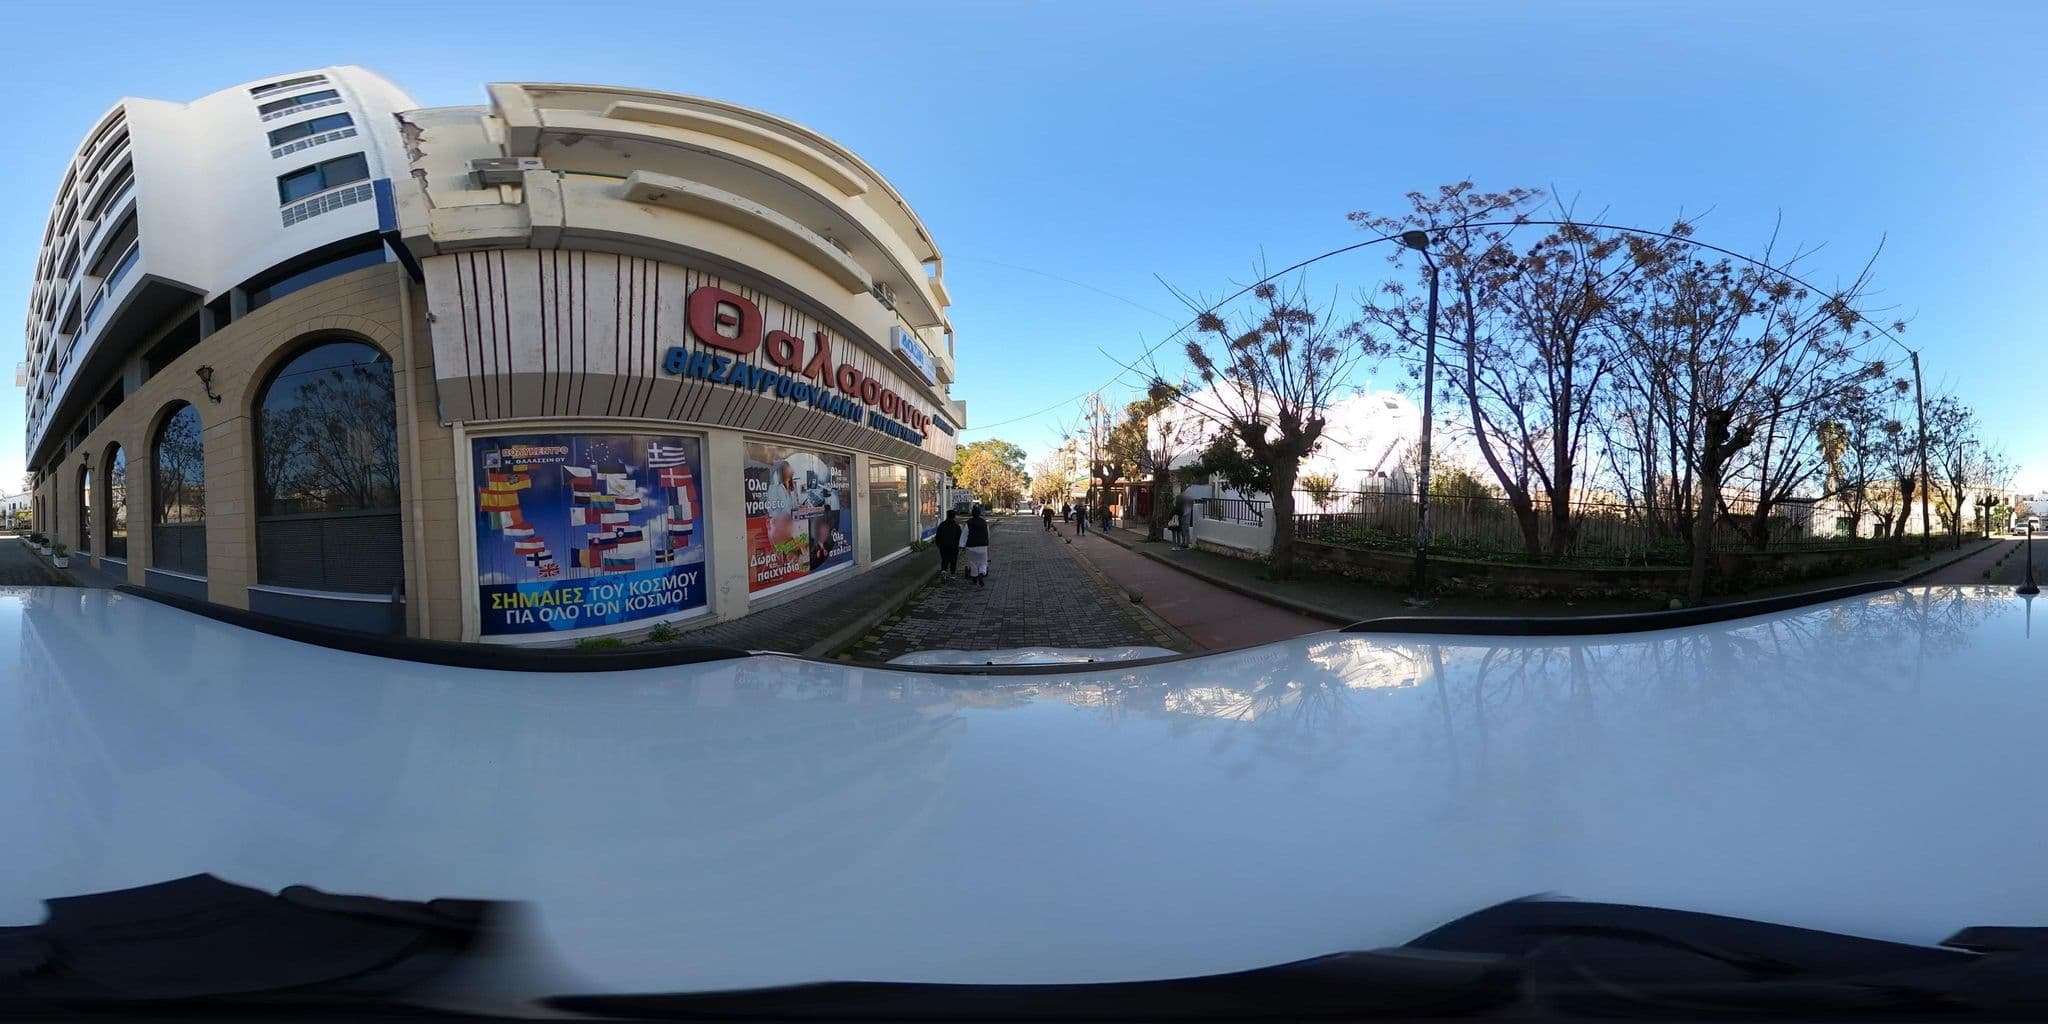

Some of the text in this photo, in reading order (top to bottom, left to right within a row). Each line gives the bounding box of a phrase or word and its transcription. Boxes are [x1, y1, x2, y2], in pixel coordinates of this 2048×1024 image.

[688, 286, 931, 439] Θαλασσινος
[663, 346, 864, 423] ΘΗΣΑΥΡΟΦΥΛΑΚΙΟ
[516, 457, 565, 465] ΘΑΛΑΣΣΙΝΟΥ
[745, 478, 768, 491] Όλα
[750, 552, 777, 567] Δώρα
[757, 561, 800, 582] παιχνίδια
[492, 571, 698, 610] ΣΗΜΑΙΕΣ ΤΟΥ ΚΟΣΜΟΥ
[506, 588, 689, 625] ΓΙΑ ΟΛΟ ΤΟΝ ΚΟΣΜΟ!
